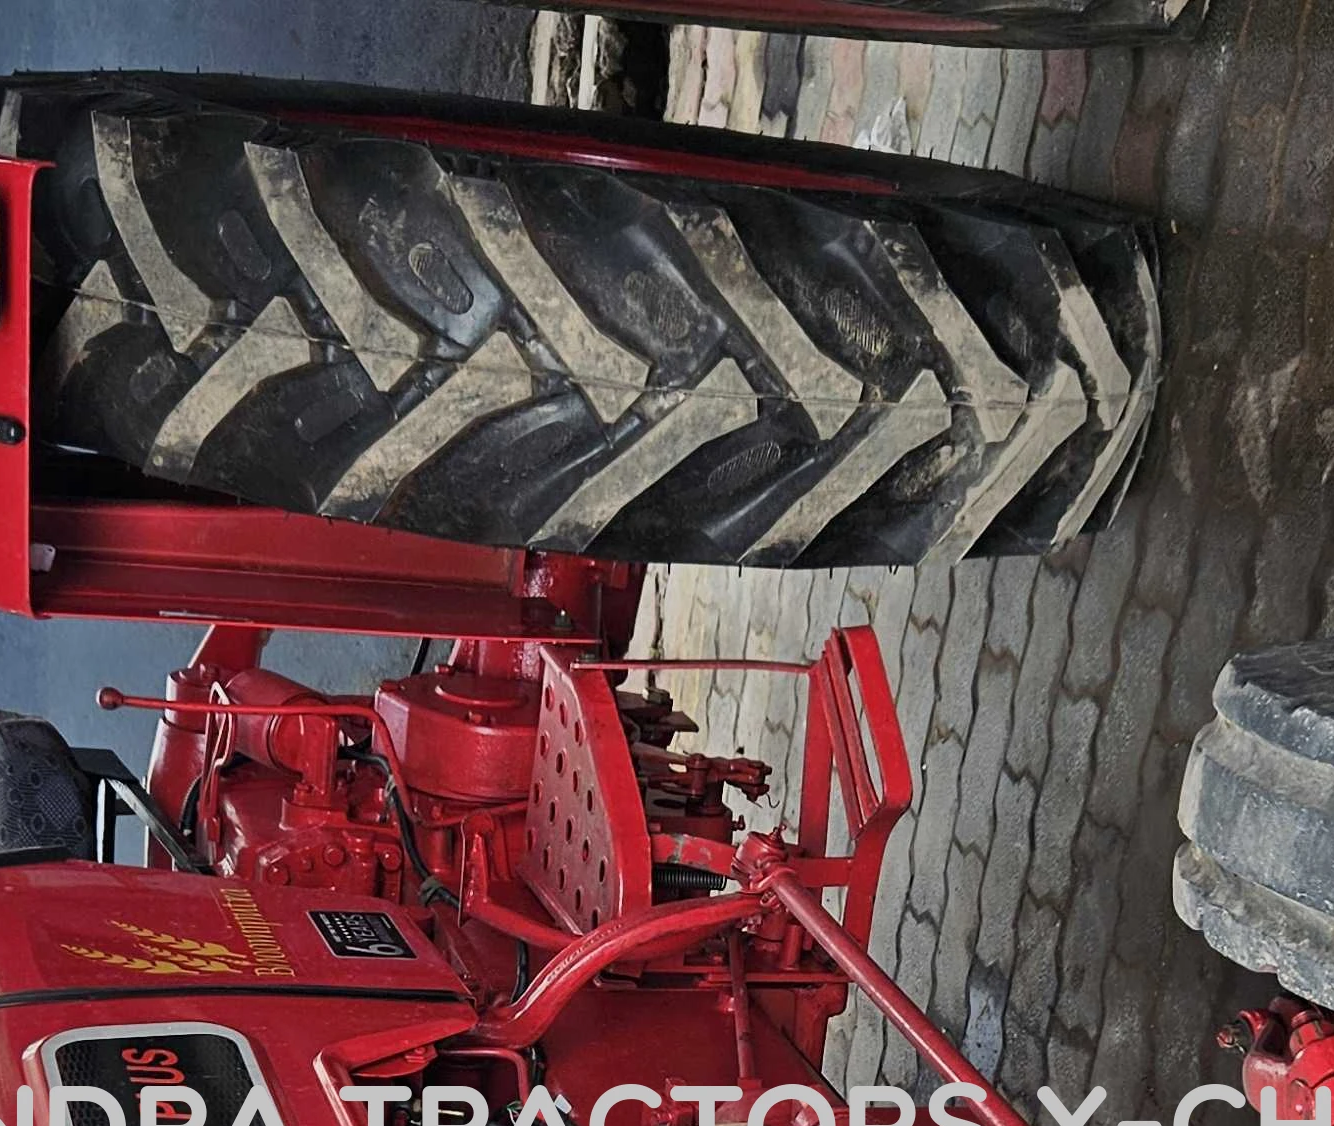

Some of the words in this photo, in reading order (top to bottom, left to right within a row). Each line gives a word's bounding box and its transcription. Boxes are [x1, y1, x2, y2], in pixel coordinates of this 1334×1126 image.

[340, 913, 380, 943] YEARS
[346, 942, 405, 956] 6
[121, 1048, 193, 1119] PUS
